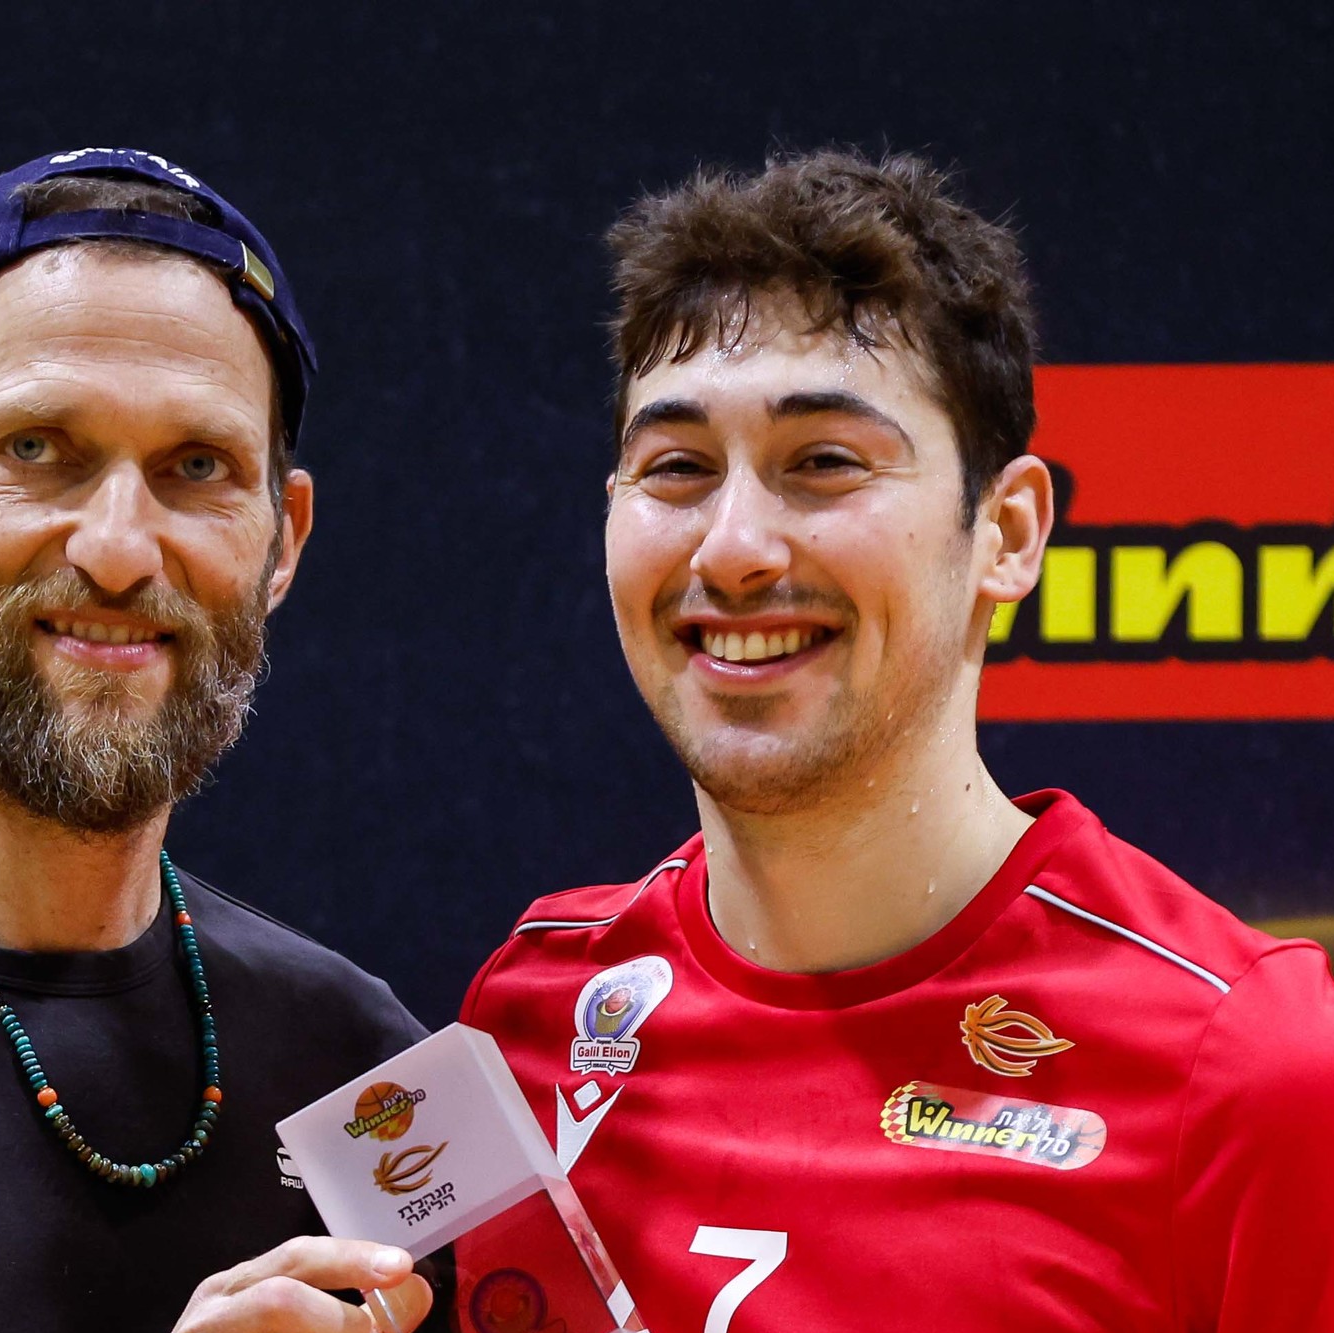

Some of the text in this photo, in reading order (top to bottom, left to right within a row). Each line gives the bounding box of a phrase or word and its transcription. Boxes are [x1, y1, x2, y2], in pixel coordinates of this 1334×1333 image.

[577, 1046, 631, 1059] Galil Elion
[345, 1099, 408, 1137] Winner
[909, 1100, 1037, 1148] Winner
[1038, 1129, 1071, 1156] סל
[280, 1176, 304, 1189] RAW
[398, 1182, 454, 1219] מנהלת
[406, 1193, 456, 1226] הליגה
